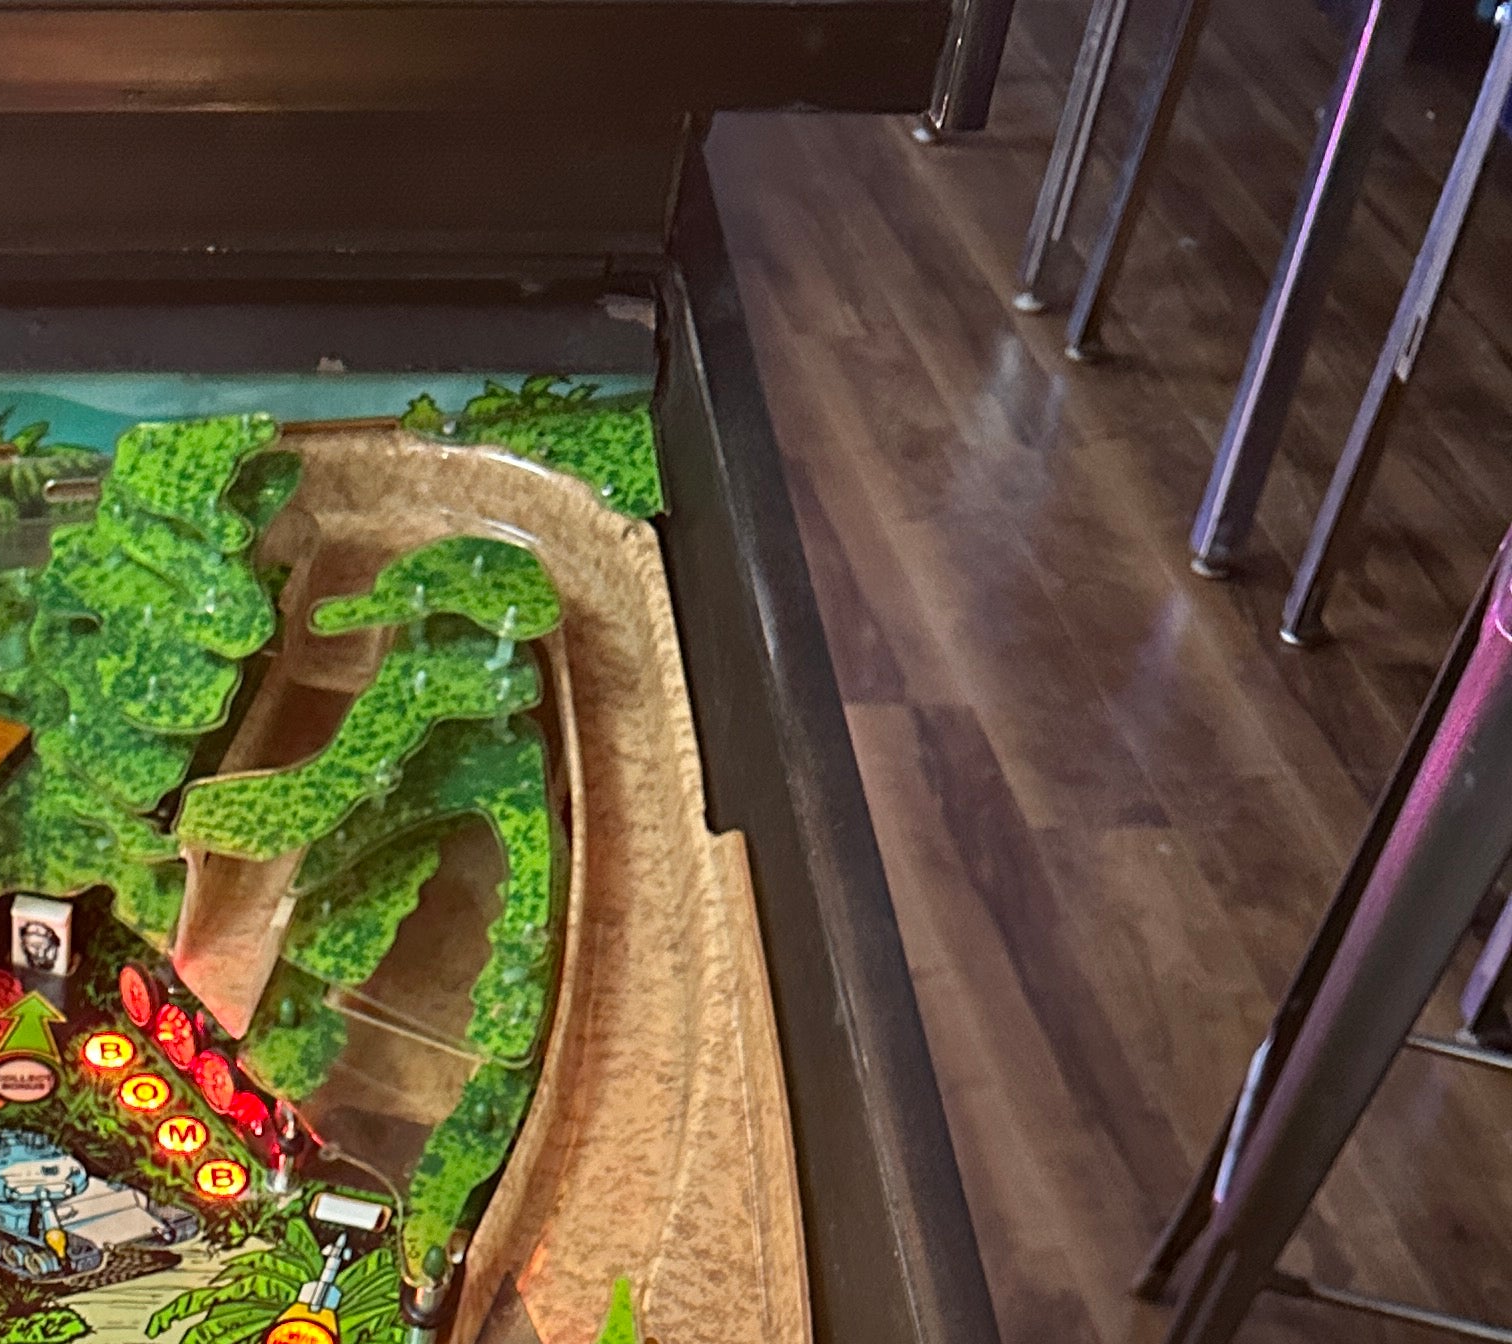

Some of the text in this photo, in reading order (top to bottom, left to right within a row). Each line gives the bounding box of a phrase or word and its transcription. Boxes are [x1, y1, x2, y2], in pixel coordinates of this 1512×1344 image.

[100, 1042, 235, 1188] B O M B
